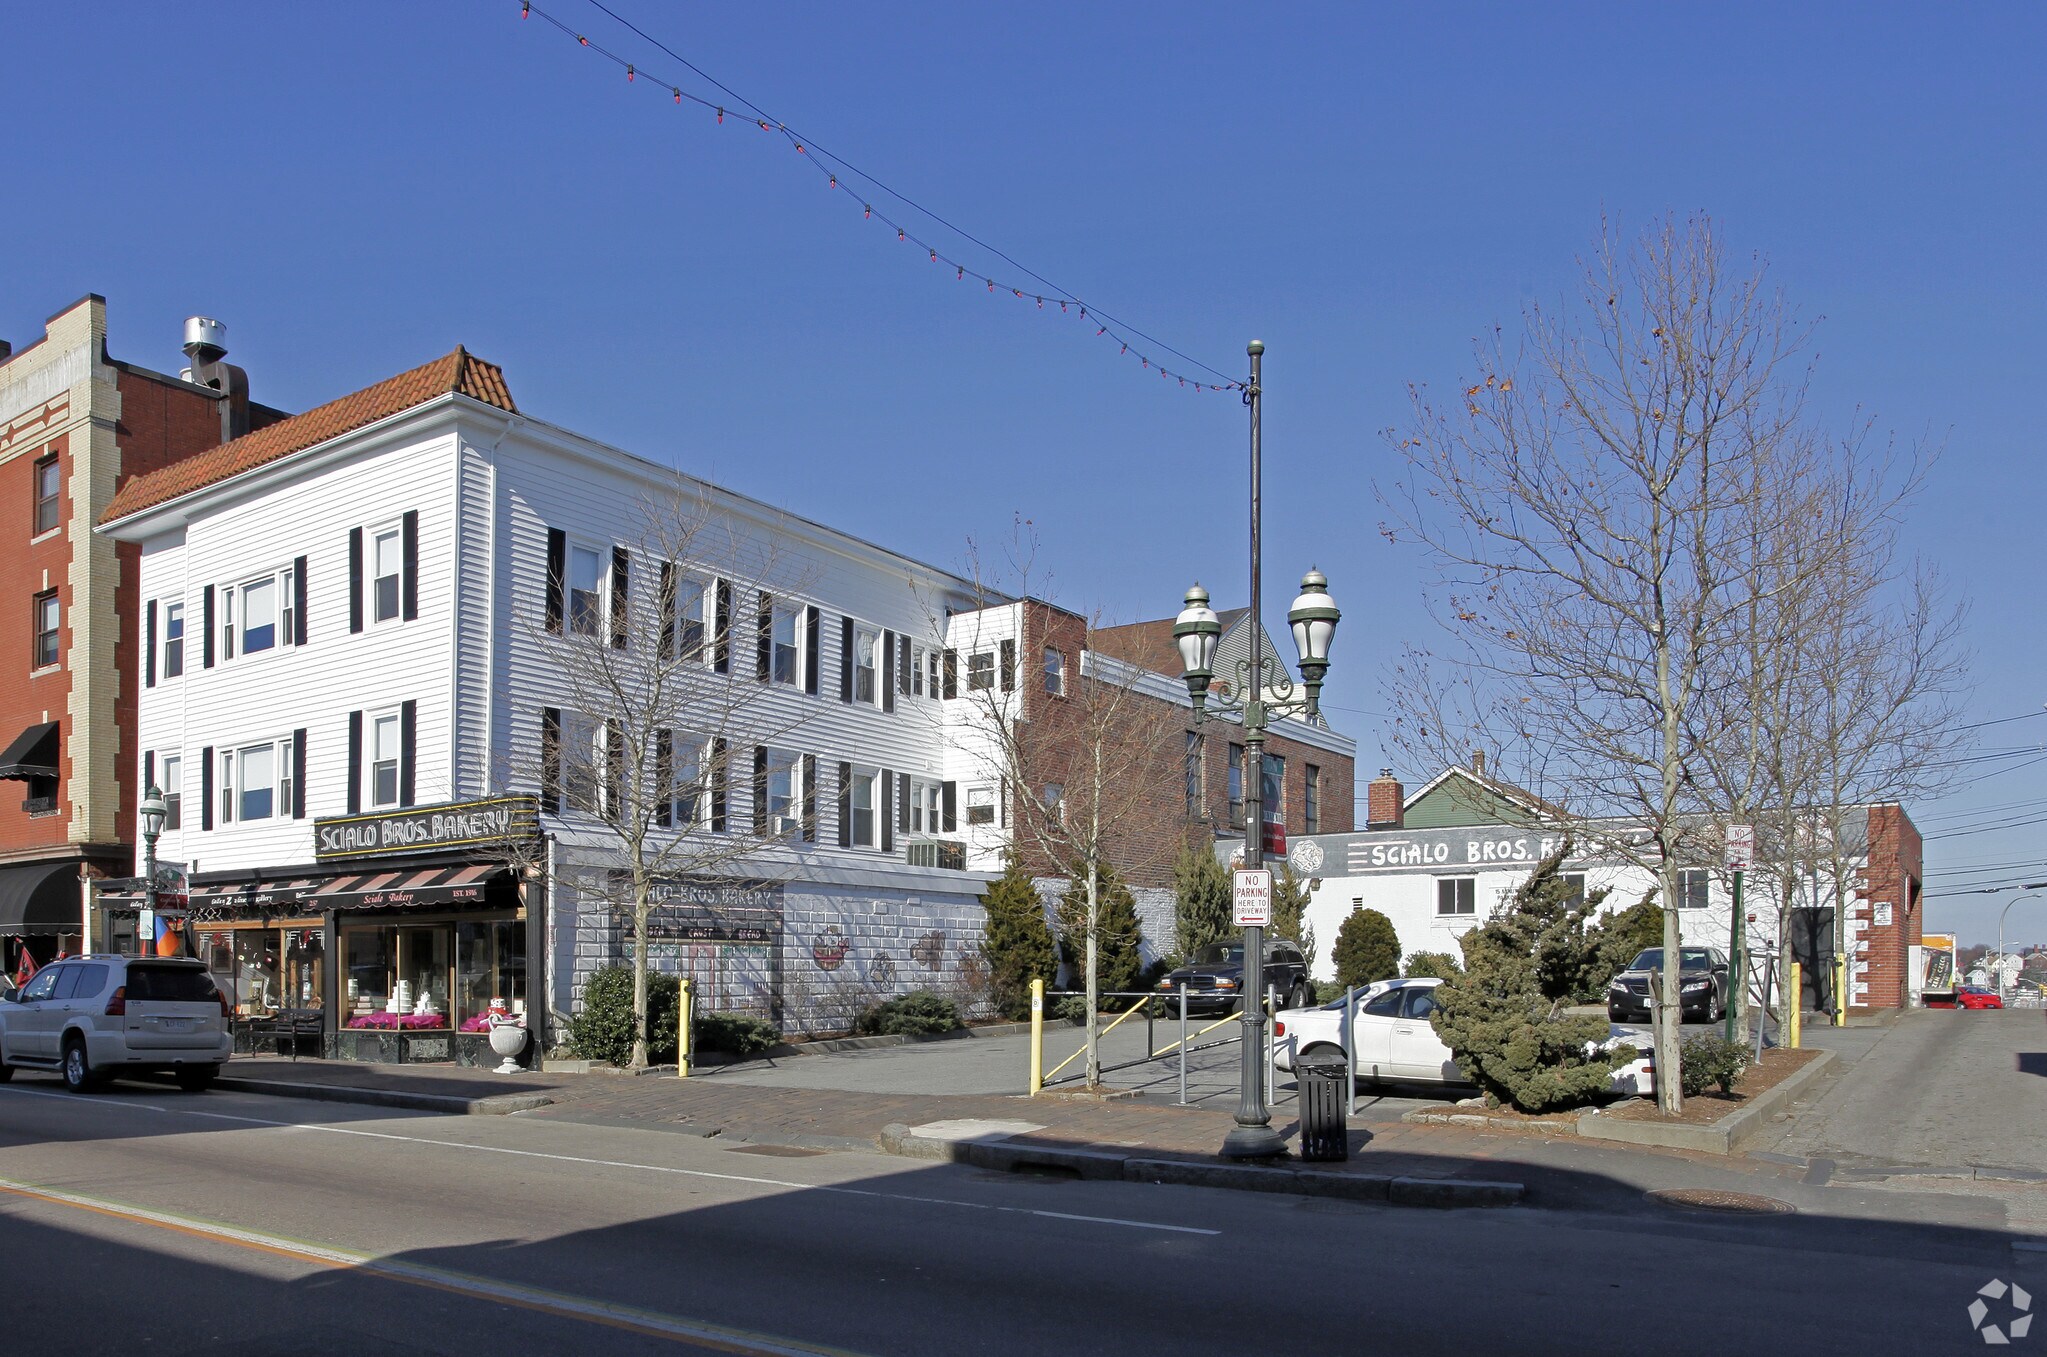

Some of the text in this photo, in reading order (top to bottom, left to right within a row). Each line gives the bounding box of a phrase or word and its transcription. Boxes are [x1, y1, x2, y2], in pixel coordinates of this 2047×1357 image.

[320, 806, 509, 851] SCIALO BROS. BAKERY
[1735, 830, 1745, 838] NO
[1371, 842, 1449, 866] SCIALO
[1467, 838, 1533, 863] BROS.
[1245, 875, 1259, 886] NO
[363, 891, 414, 904] Scialo Bakery
[722, 887, 771, 905] BAKERY
[1236, 887, 1267, 898] PARKING
[226, 896, 233, 905] Z
[1237, 899, 1267, 907] HERE TO
[1236, 907, 1267, 915] DRIVEWAY
[688, 928, 714, 938] CRUST
[738, 929, 761, 939] BREAD
